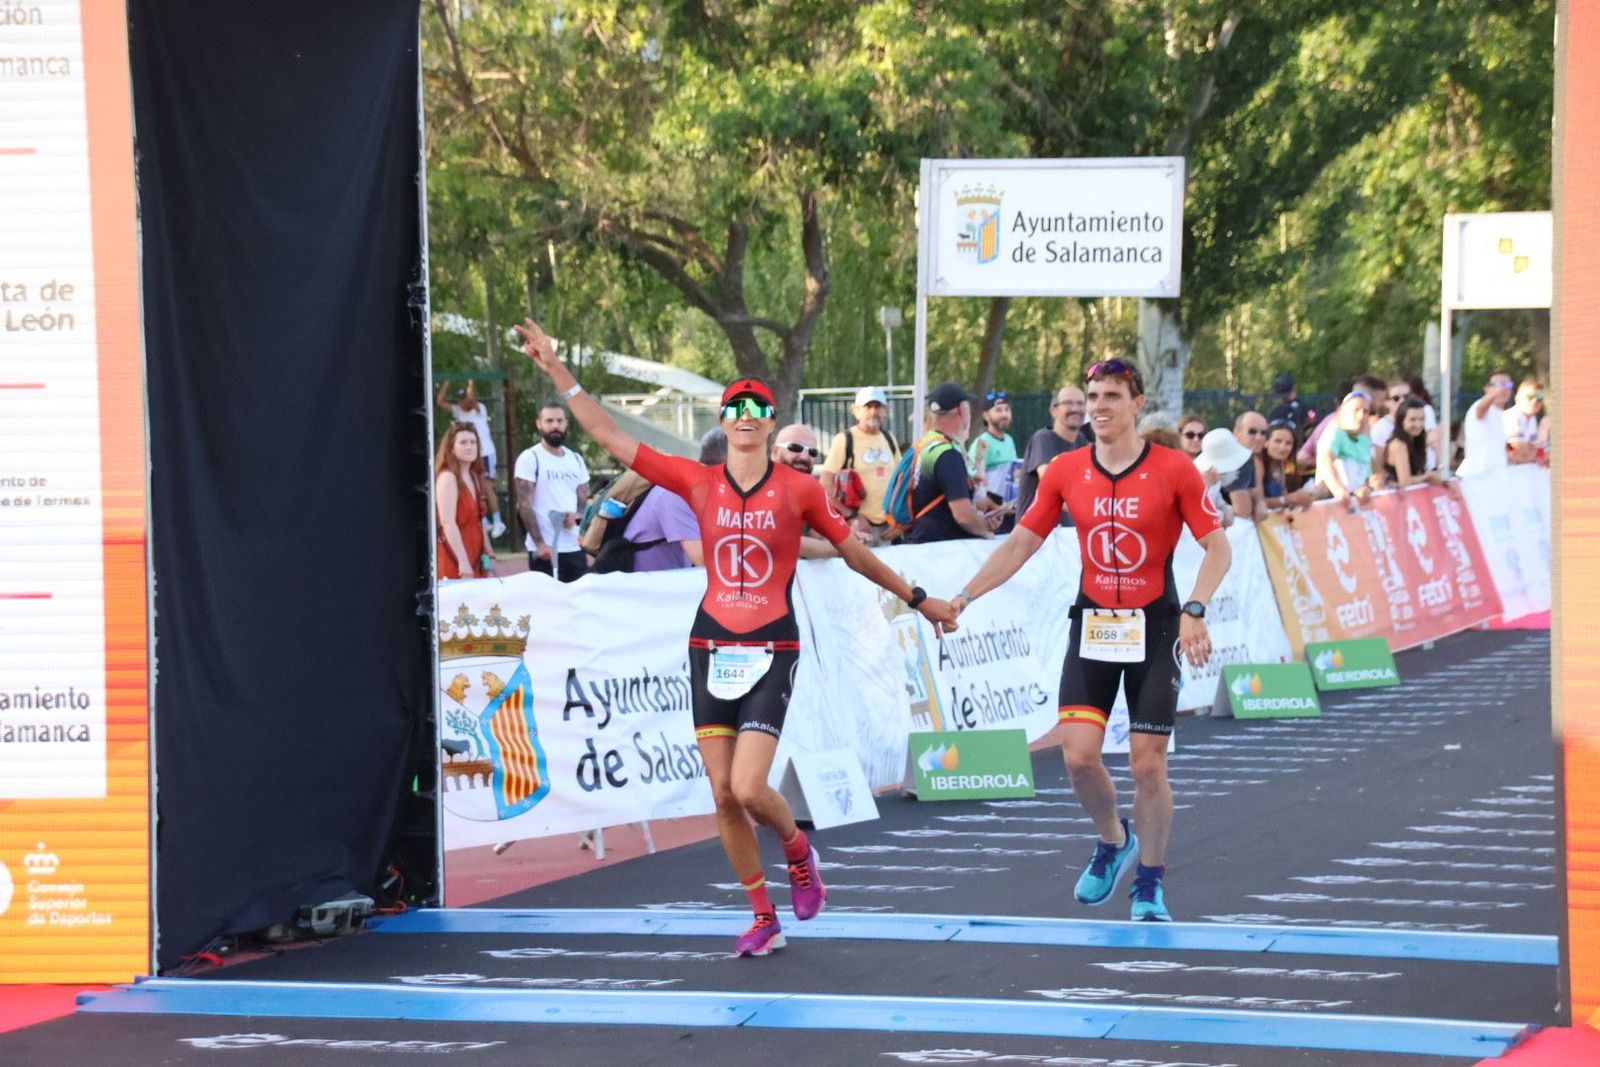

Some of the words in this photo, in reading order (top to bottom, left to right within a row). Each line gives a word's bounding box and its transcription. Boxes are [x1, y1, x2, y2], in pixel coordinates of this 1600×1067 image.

[1012, 210, 1164, 238] Ayuntamiento
[1012, 241, 1036, 263] de
[1045, 240, 1162, 263] Salamanca
[41, 279, 75, 302] de
[5, 306, 75, 331] León
[29, 475, 47, 487] de
[1093, 497, 1139, 519] KIKE
[716, 507, 776, 529] MARTA
[1095, 573, 1147, 586] Kalamos
[716, 591, 769, 606] Kalamos
[1089, 630, 1118, 640] 1058
[716, 668, 745, 679] 1644
[1326, 668, 1395, 684] IBERDROLA
[0, 686, 90, 710] amiento
[1243, 697, 1317, 711] IBERDROLA
[576, 738, 629, 792] de
[931, 773, 1029, 790] IBERDROLA
